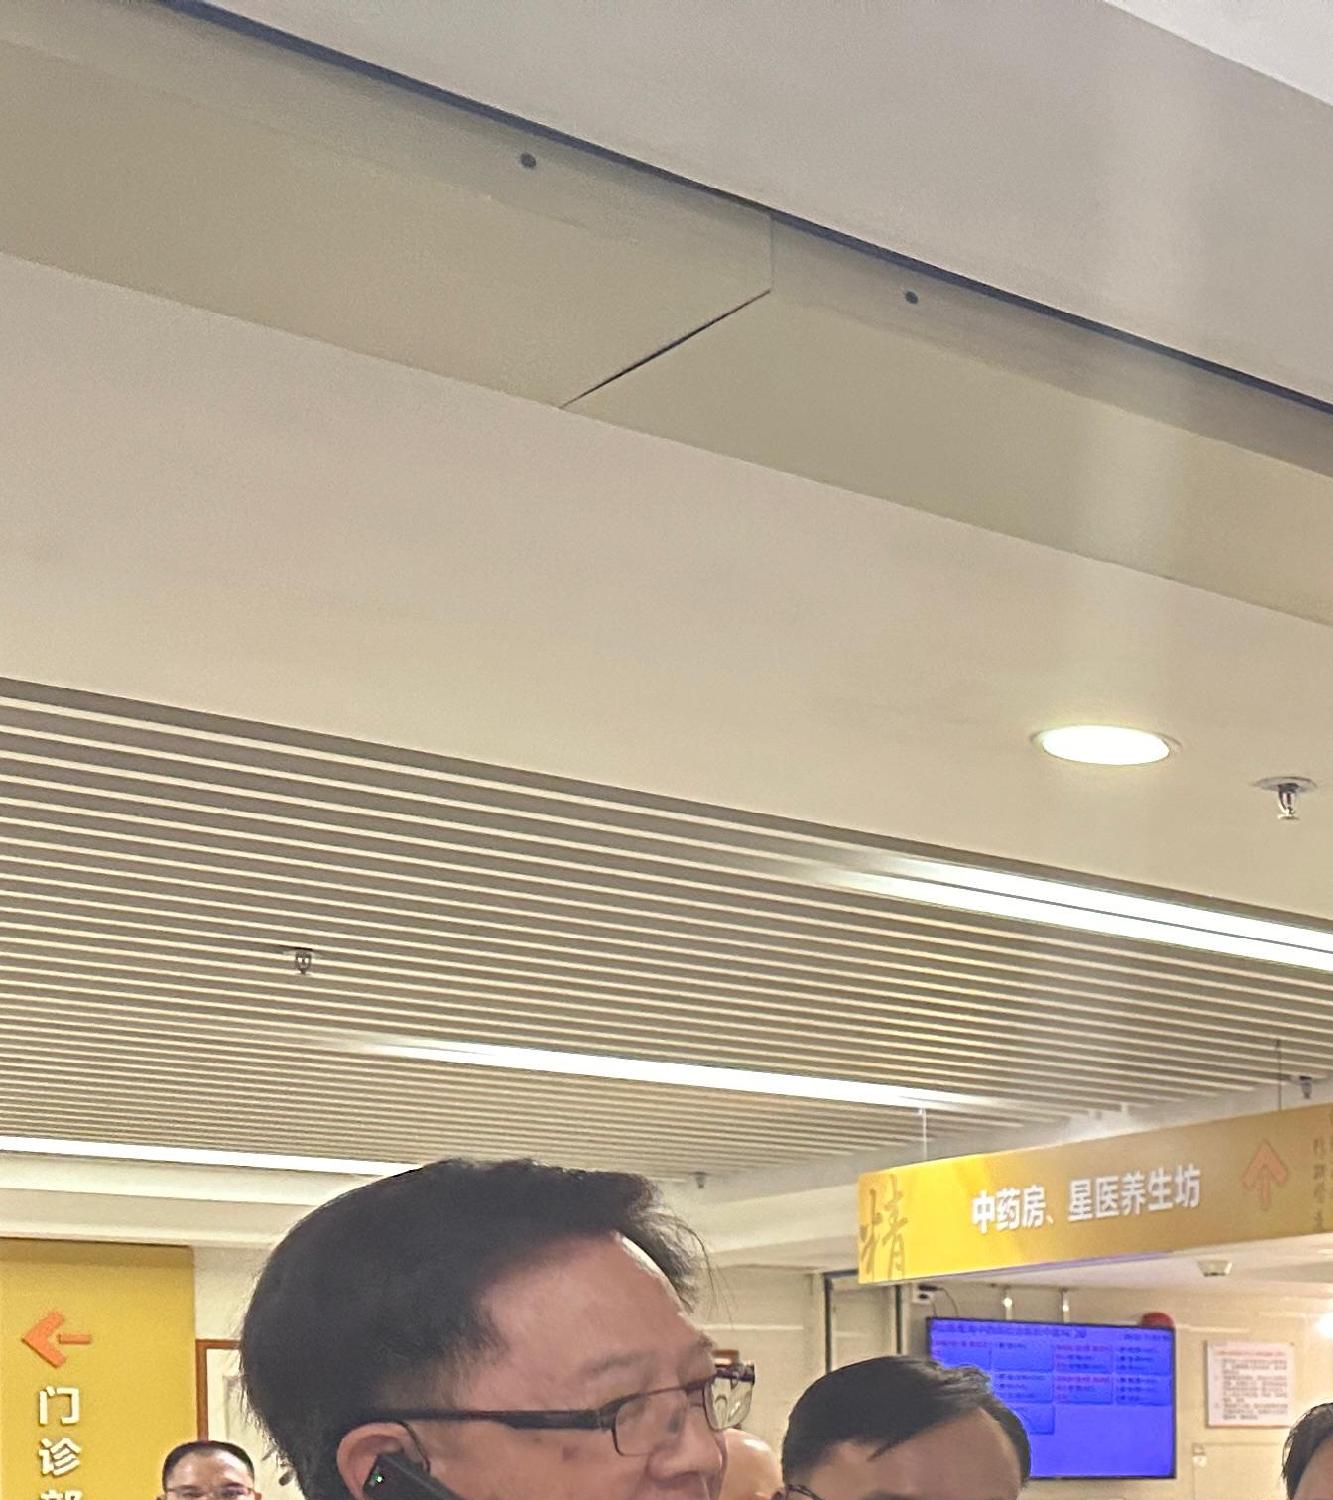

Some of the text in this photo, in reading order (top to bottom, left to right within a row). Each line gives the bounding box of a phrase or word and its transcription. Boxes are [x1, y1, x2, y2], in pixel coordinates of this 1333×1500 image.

[970, 1163, 1201, 1234] 中药房、星医养生坊
